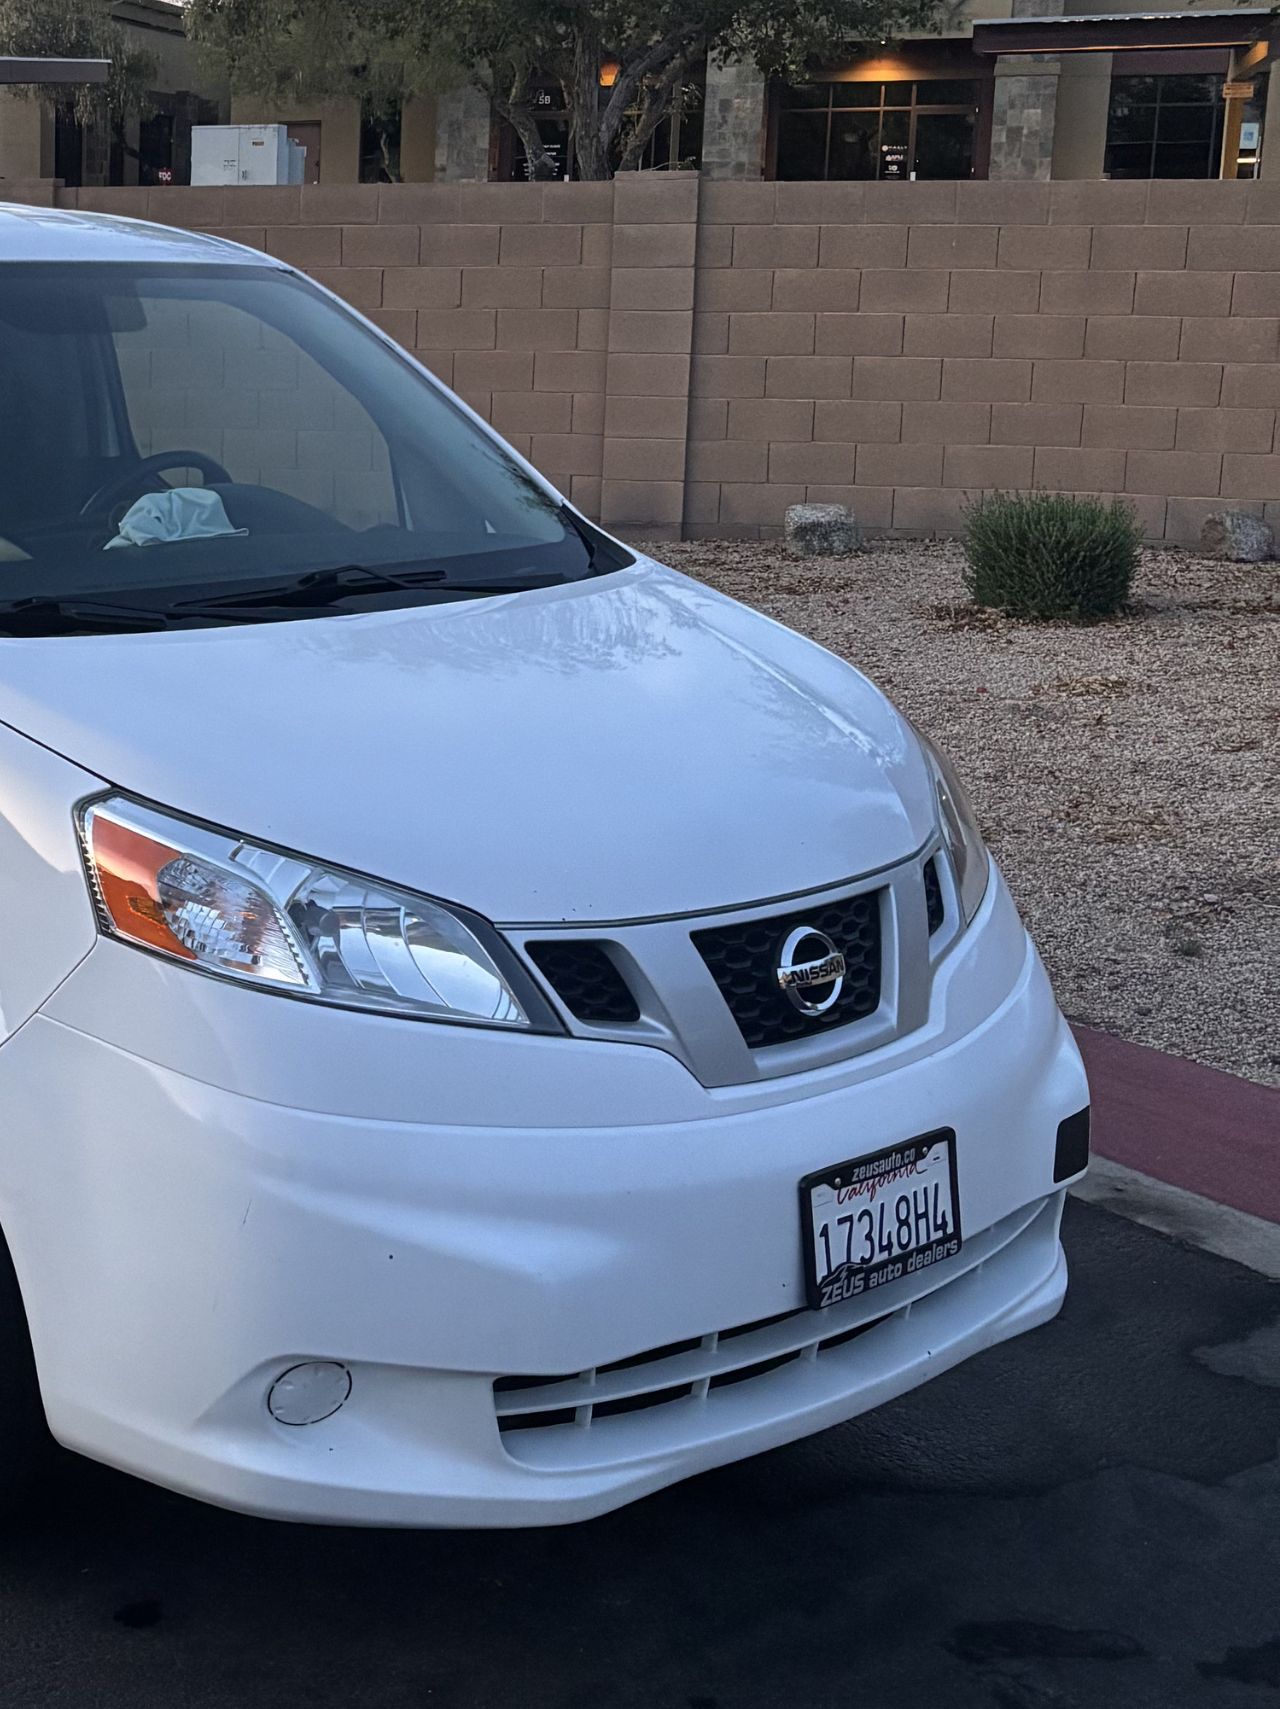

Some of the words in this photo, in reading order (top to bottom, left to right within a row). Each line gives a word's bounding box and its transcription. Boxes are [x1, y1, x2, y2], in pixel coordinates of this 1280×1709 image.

[790, 957, 845, 984] NISSAN
[837, 1162, 928, 1205] California
[852, 1149, 916, 1182] zeusauto.co
[819, 1182, 948, 1279] 17348H4
[821, 1272, 865, 1307] ZEUS
[869, 1263, 903, 1287] auto
[907, 1239, 958, 1273] dealers
